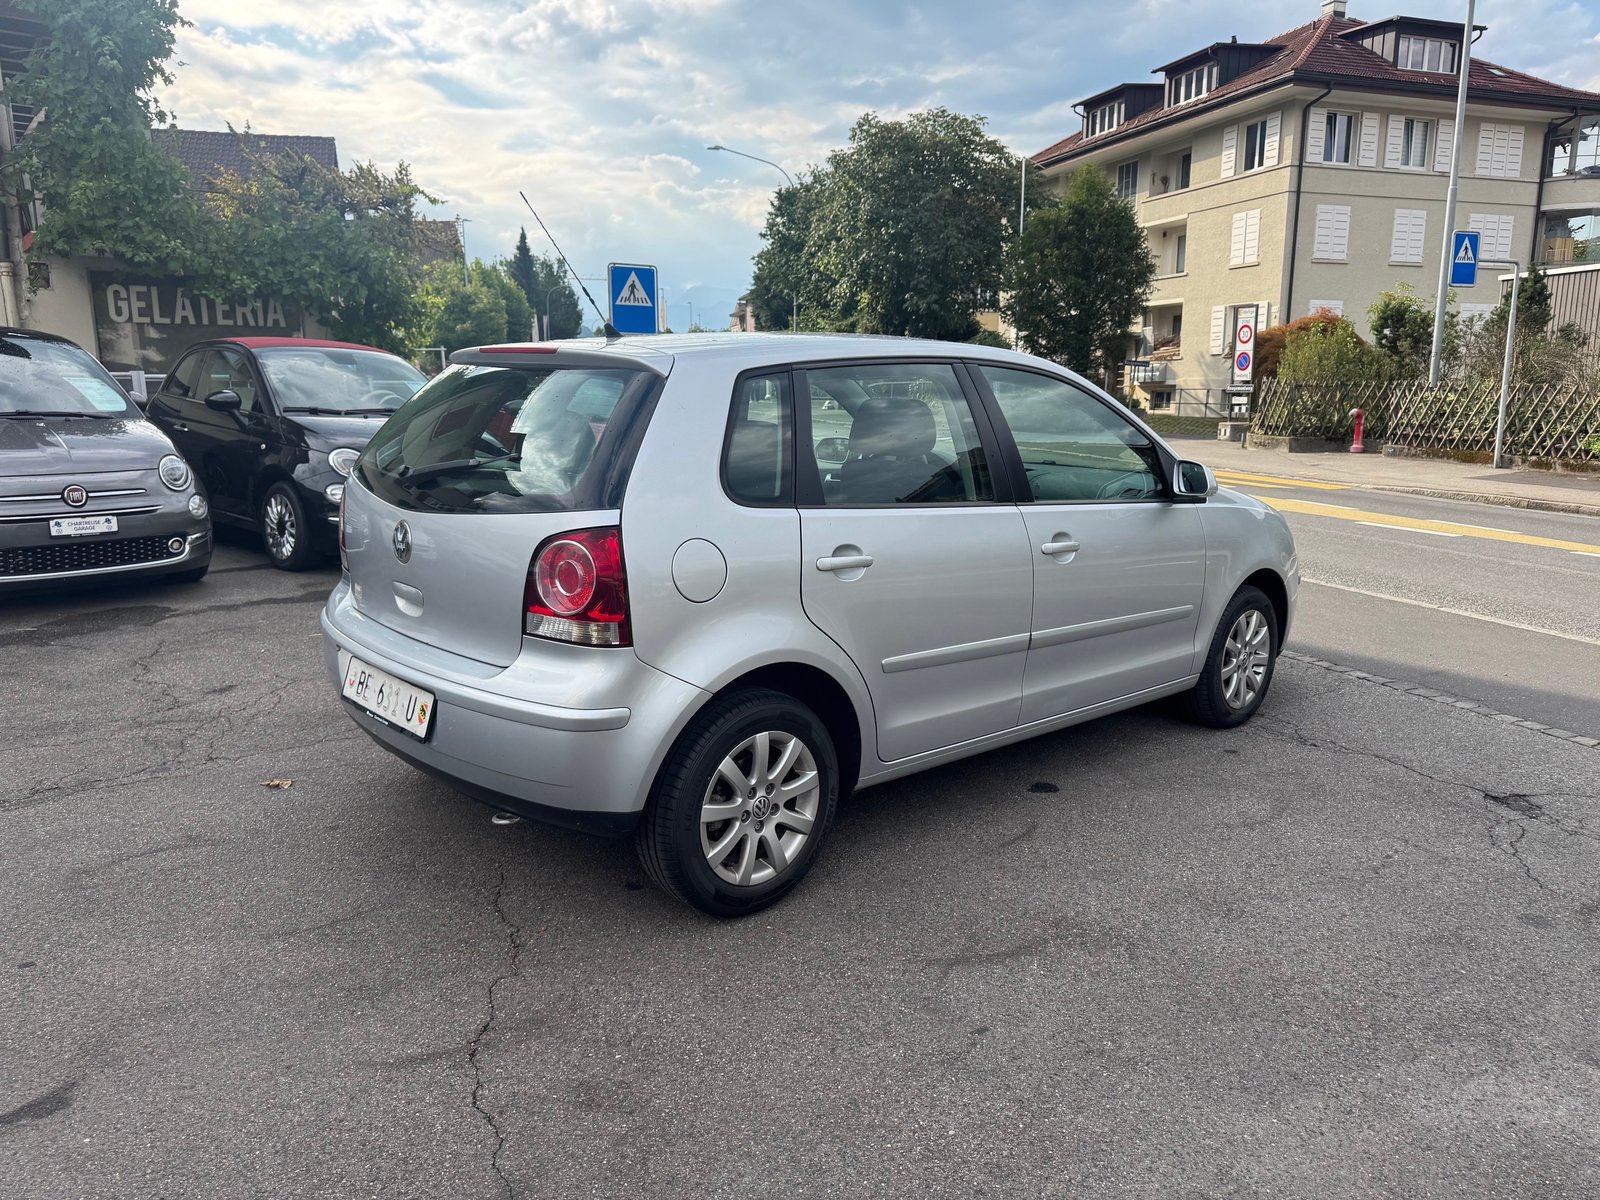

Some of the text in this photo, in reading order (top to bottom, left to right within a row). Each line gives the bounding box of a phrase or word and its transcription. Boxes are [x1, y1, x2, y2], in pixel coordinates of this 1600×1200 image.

[69, 491, 82, 501] FIAT
[356, 670, 375, 703] BE
[405, 693, 418, 722] U
